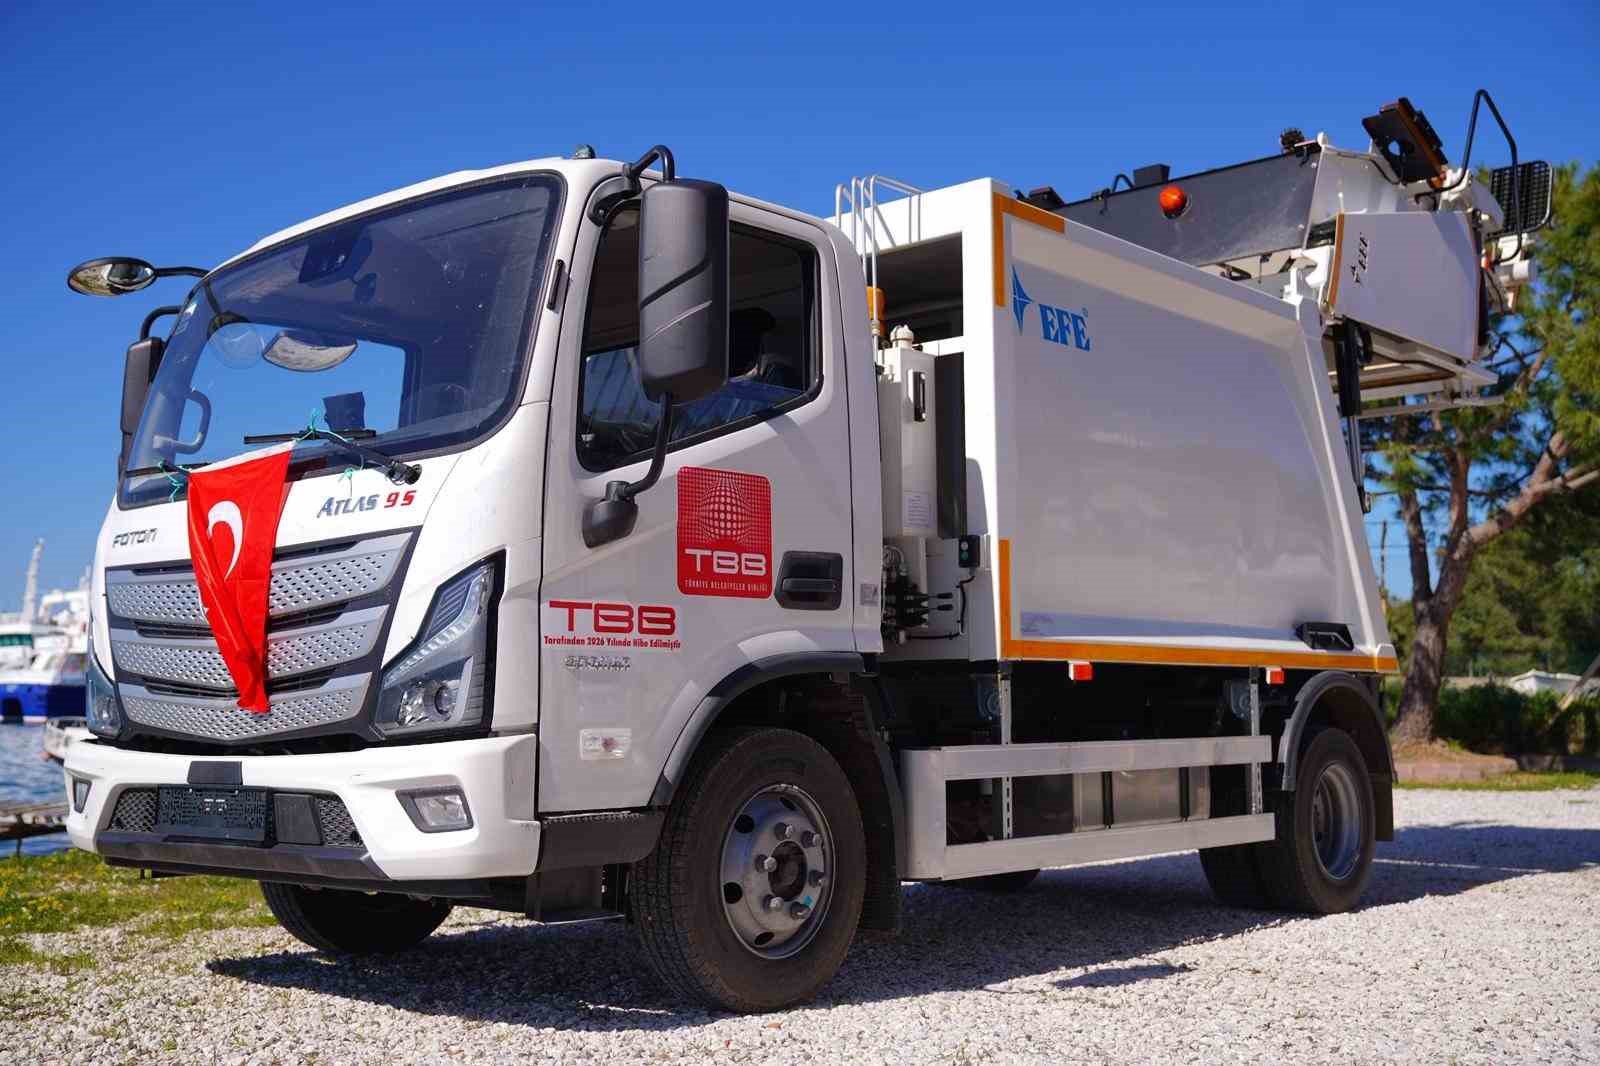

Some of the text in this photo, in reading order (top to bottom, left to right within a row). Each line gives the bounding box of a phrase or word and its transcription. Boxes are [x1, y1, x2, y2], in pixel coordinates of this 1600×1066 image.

[1039, 303, 1090, 352] EFE
[316, 489, 417, 518] ATLAS 95
[112, 528, 158, 548] FOTON
[684, 548, 767, 576] TBB
[549, 600, 676, 635] TBB
